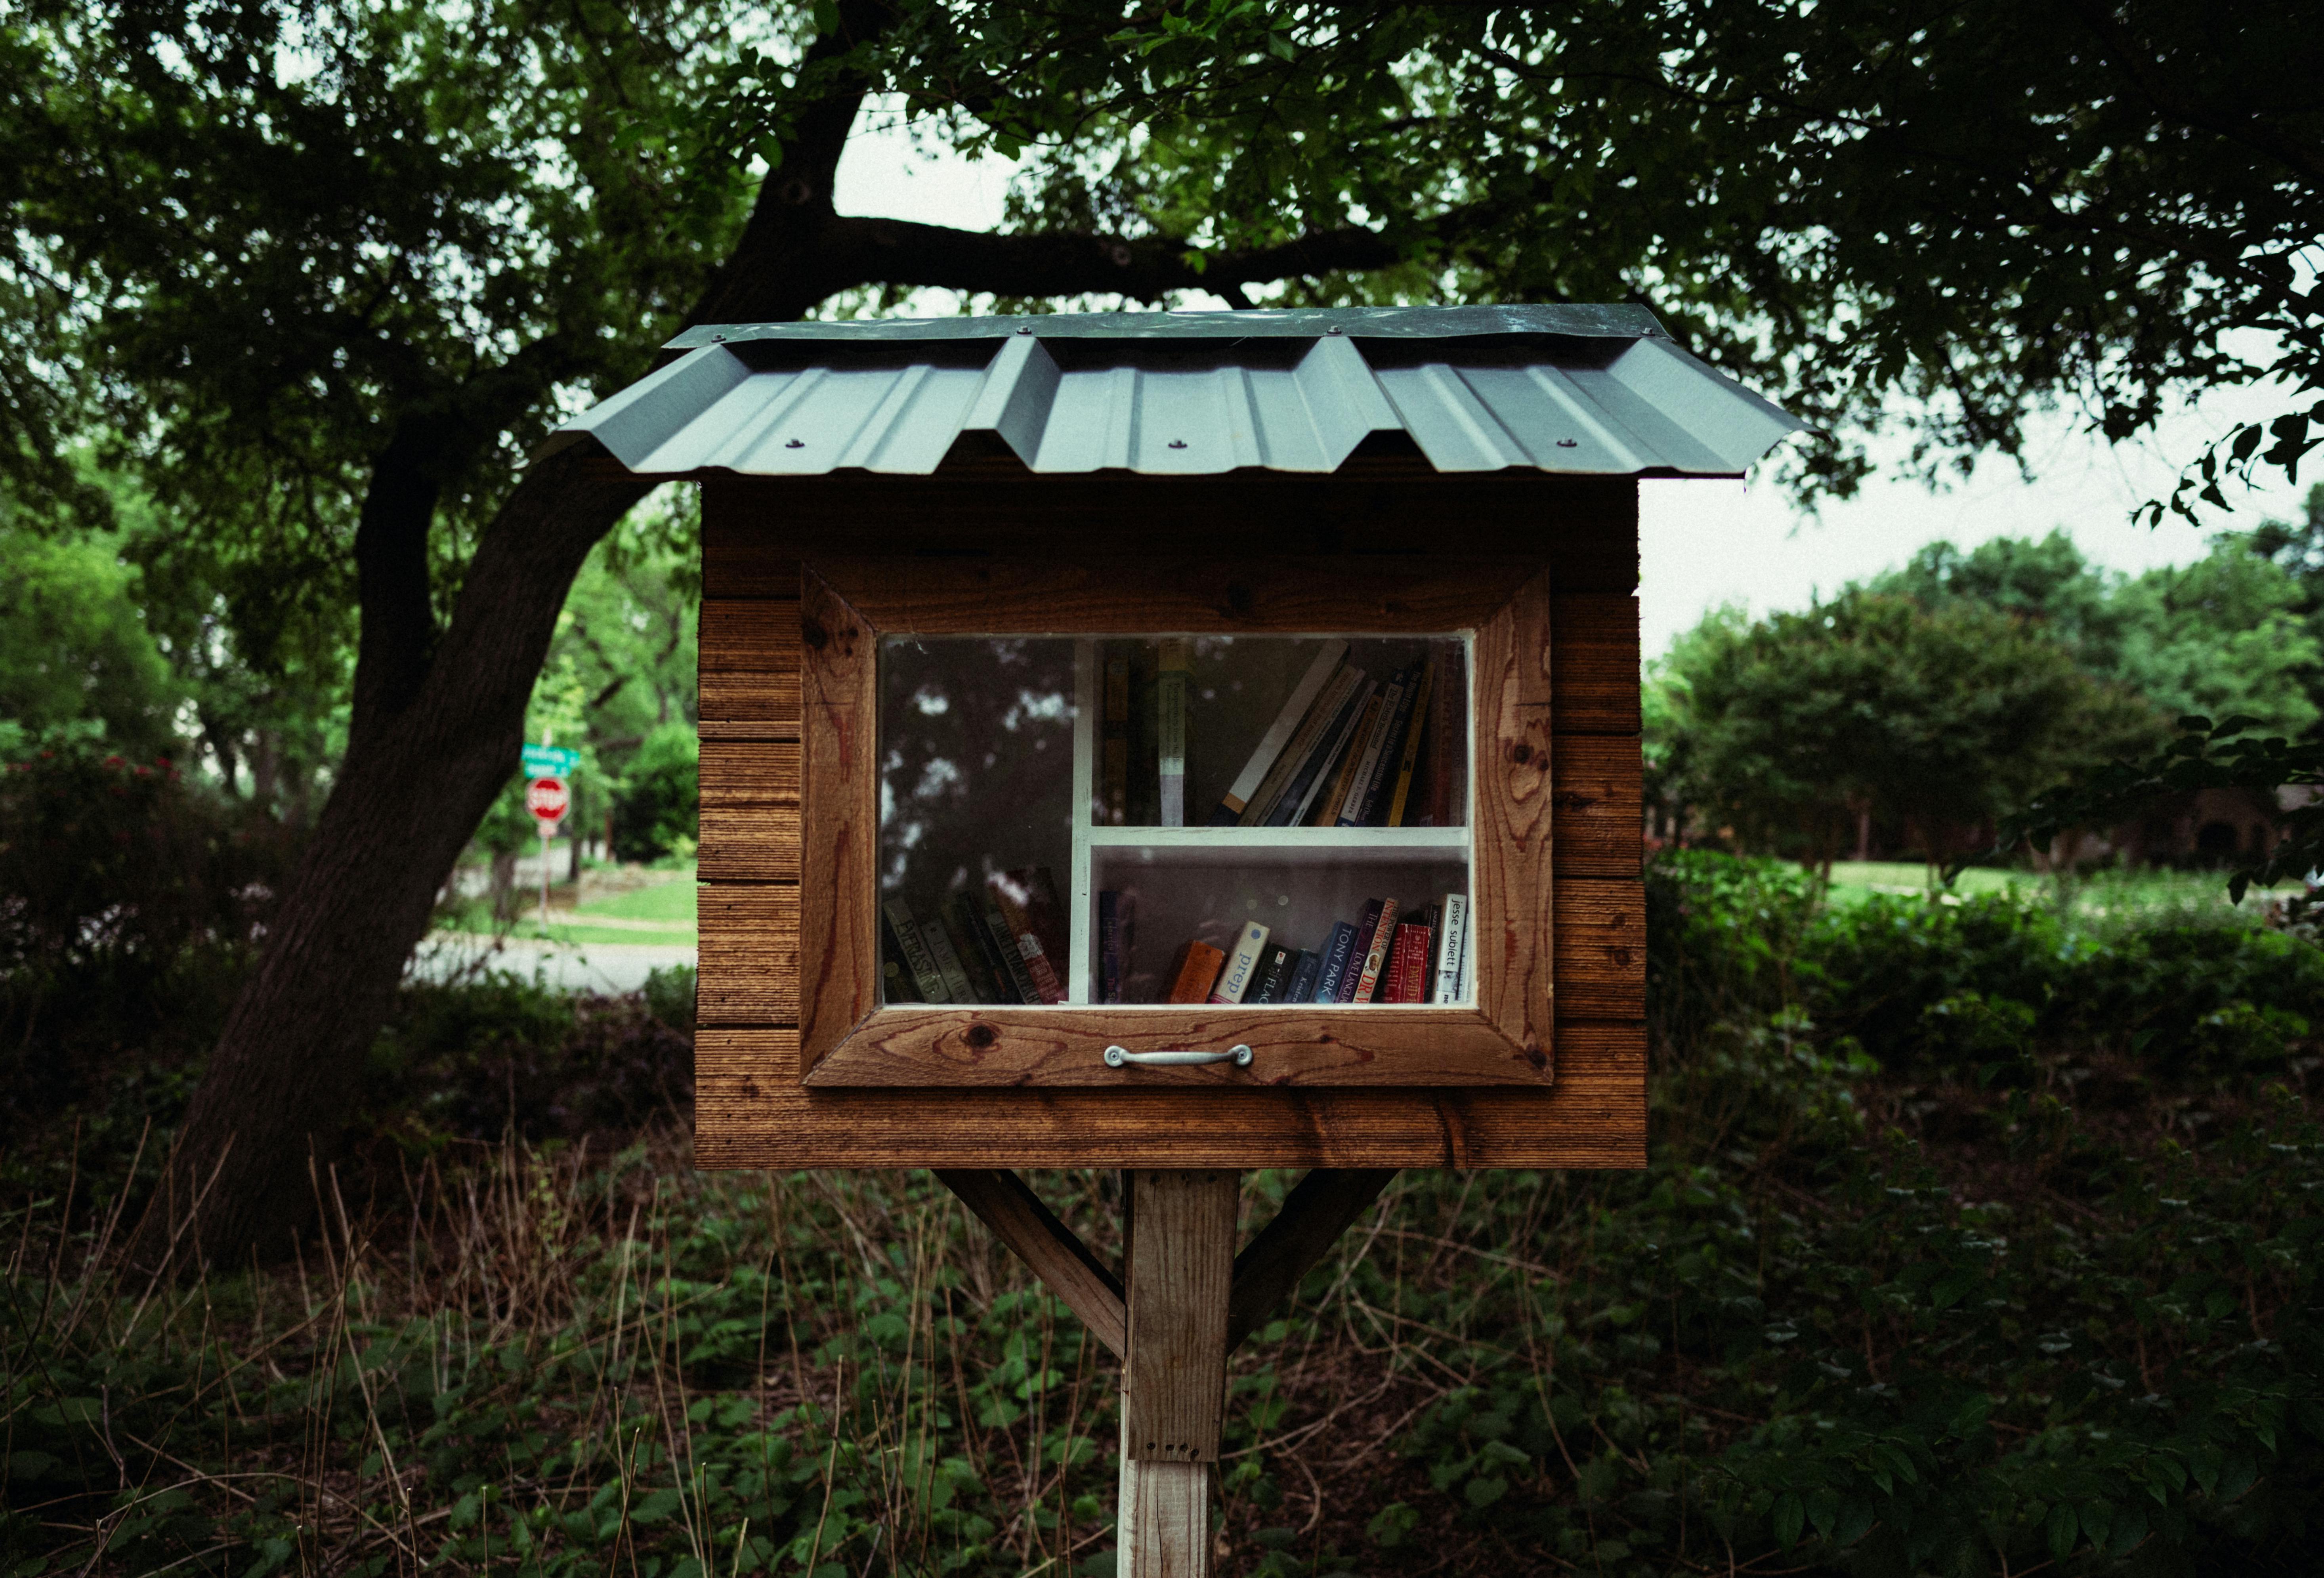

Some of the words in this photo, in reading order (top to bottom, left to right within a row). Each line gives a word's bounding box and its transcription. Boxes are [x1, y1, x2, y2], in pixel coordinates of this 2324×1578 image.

[1410, 671, 1421, 682] The
[1389, 688, 1398, 700] The
[1403, 680, 1417, 699] Slight
[1398, 697, 1411, 713] Edge
[1371, 722, 1386, 749] Revisited
[1389, 718, 1402, 739] Secret
[1358, 760, 1371, 785] MICHAEL
[1374, 749, 1392, 781] Successful
[1369, 779, 1380, 792] Life
[1348, 792, 1360, 814] GERBER
[1365, 913, 1379, 928] THE
[1390, 906, 1400, 919] THE
[1451, 898, 1463, 925] jesse
[1371, 900, 1395, 951] INTENTION
[1383, 919, 1395, 940] POWER
[896, 918, 940, 994] EVERLASTING
[934, 940, 955, 972] JAMES
[1334, 928, 1352, 962] TONY
[1380, 941, 1388, 950] OF
[1446, 930, 1457, 967] sublett
[991, 921, 1014, 948] JANET
[1006, 951, 1040, 1003] EVANOVICH
[1228, 952, 1251, 993] prep
[1351, 952, 1365, 972] LOVE
[1292, 976, 1307, 1002] Kristen
[1321, 963, 1340, 995] PARK
[1358, 974, 1376, 993] DR.
[1408, 966, 1420, 996] DAVID
